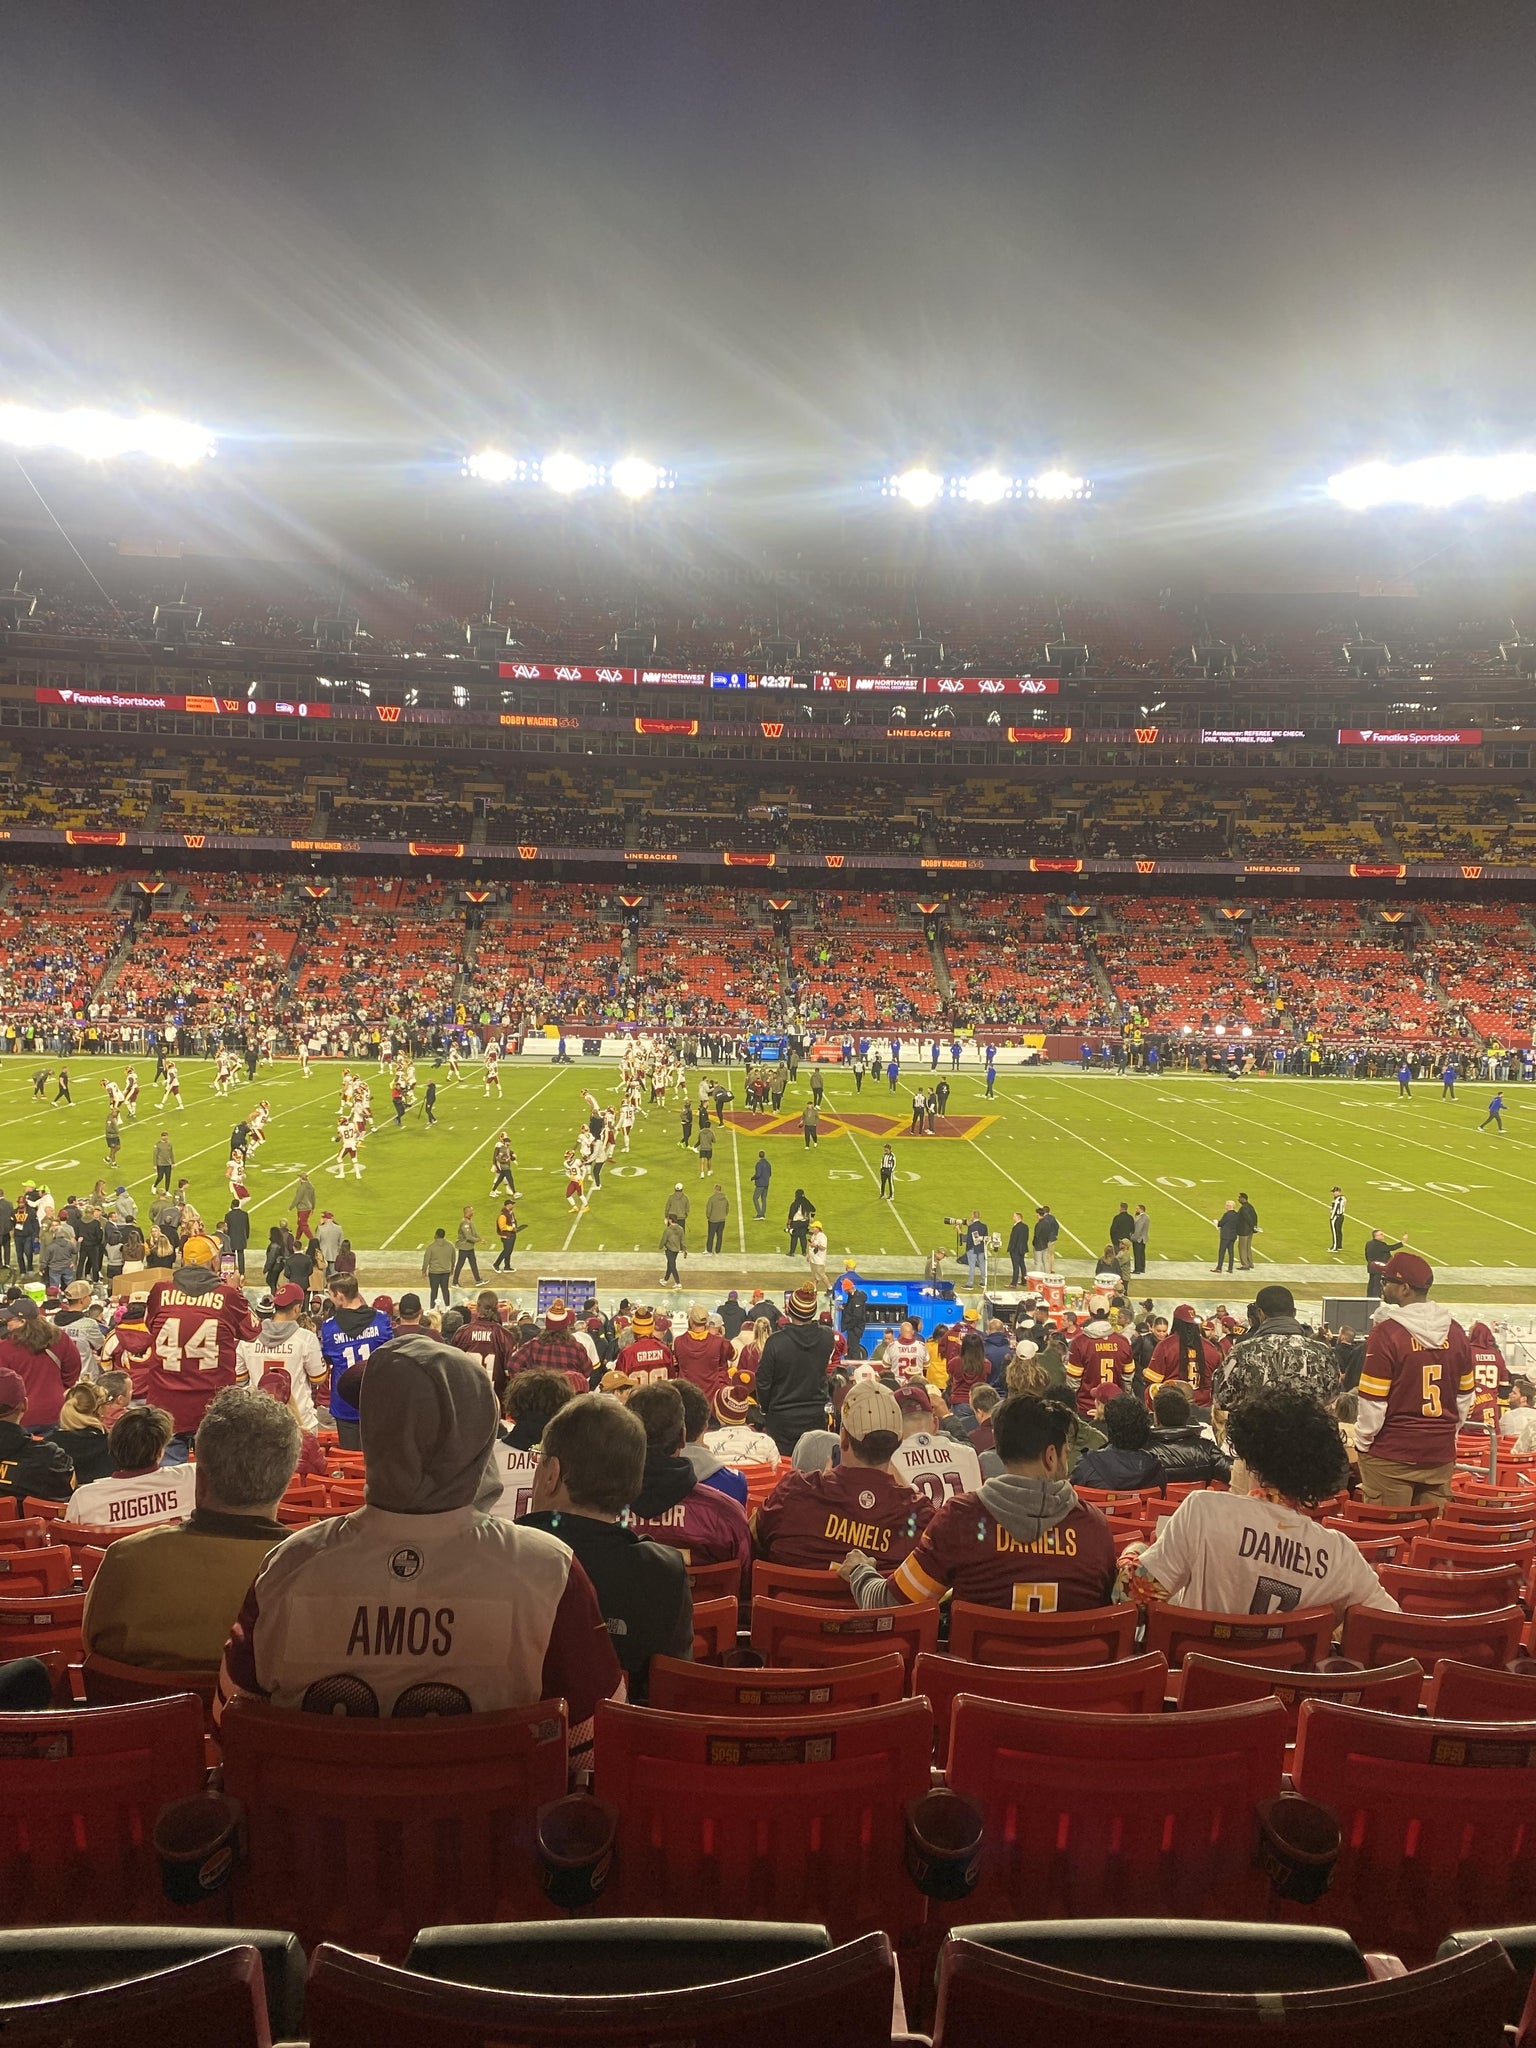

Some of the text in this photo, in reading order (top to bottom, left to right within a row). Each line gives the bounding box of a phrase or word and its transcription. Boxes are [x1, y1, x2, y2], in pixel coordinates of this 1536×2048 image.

[662, 673, 706, 681] NORTHWEST
[731, 674, 738, 684] 0
[760, 675, 791, 688] 42:37
[823, 677, 830, 687] 0
[73, 692, 166, 708] Fanatics Sportsbook
[247, 701, 256, 715] 0
[299, 703, 307, 717] 0
[500, 714, 526, 726] BOBBY
[527, 715, 558, 728] WAGNER
[886, 729, 951, 738] LINEBACKER
[1373, 733, 1461, 744] Fanatics Sportsbook
[291, 840, 314, 850] BOBBY
[315, 842, 342, 851] WAGNER
[624, 853, 678, 861] LINEBACKER
[920, 859, 941, 868] BOBBY
[942, 860, 967, 868] WAGNER
[343, 1127, 355, 1140] 87
[1102, 1174, 1197, 1188] 40
[1365, 1179, 1472, 1194] 30
[471, 1330, 492, 1342] MONK
[155, 1317, 219, 1372] 44
[898, 1346, 918, 1354] TAYLOR
[1094, 1342, 1118, 1352] DANIELS
[636, 1349, 664, 1362] GREEN
[1100, 1357, 1115, 1383] 5
[1475, 1364, 1499, 1389] 59
[1422, 1364, 1443, 1418] 5
[902, 1448, 953, 1467] TAYLOR
[109, 1490, 179, 1523] RIGGINS
[824, 1513, 891, 1553] DANIELS
[1238, 1526, 1329, 1580] DANIELS
[345, 1604, 455, 1657] AMOS
